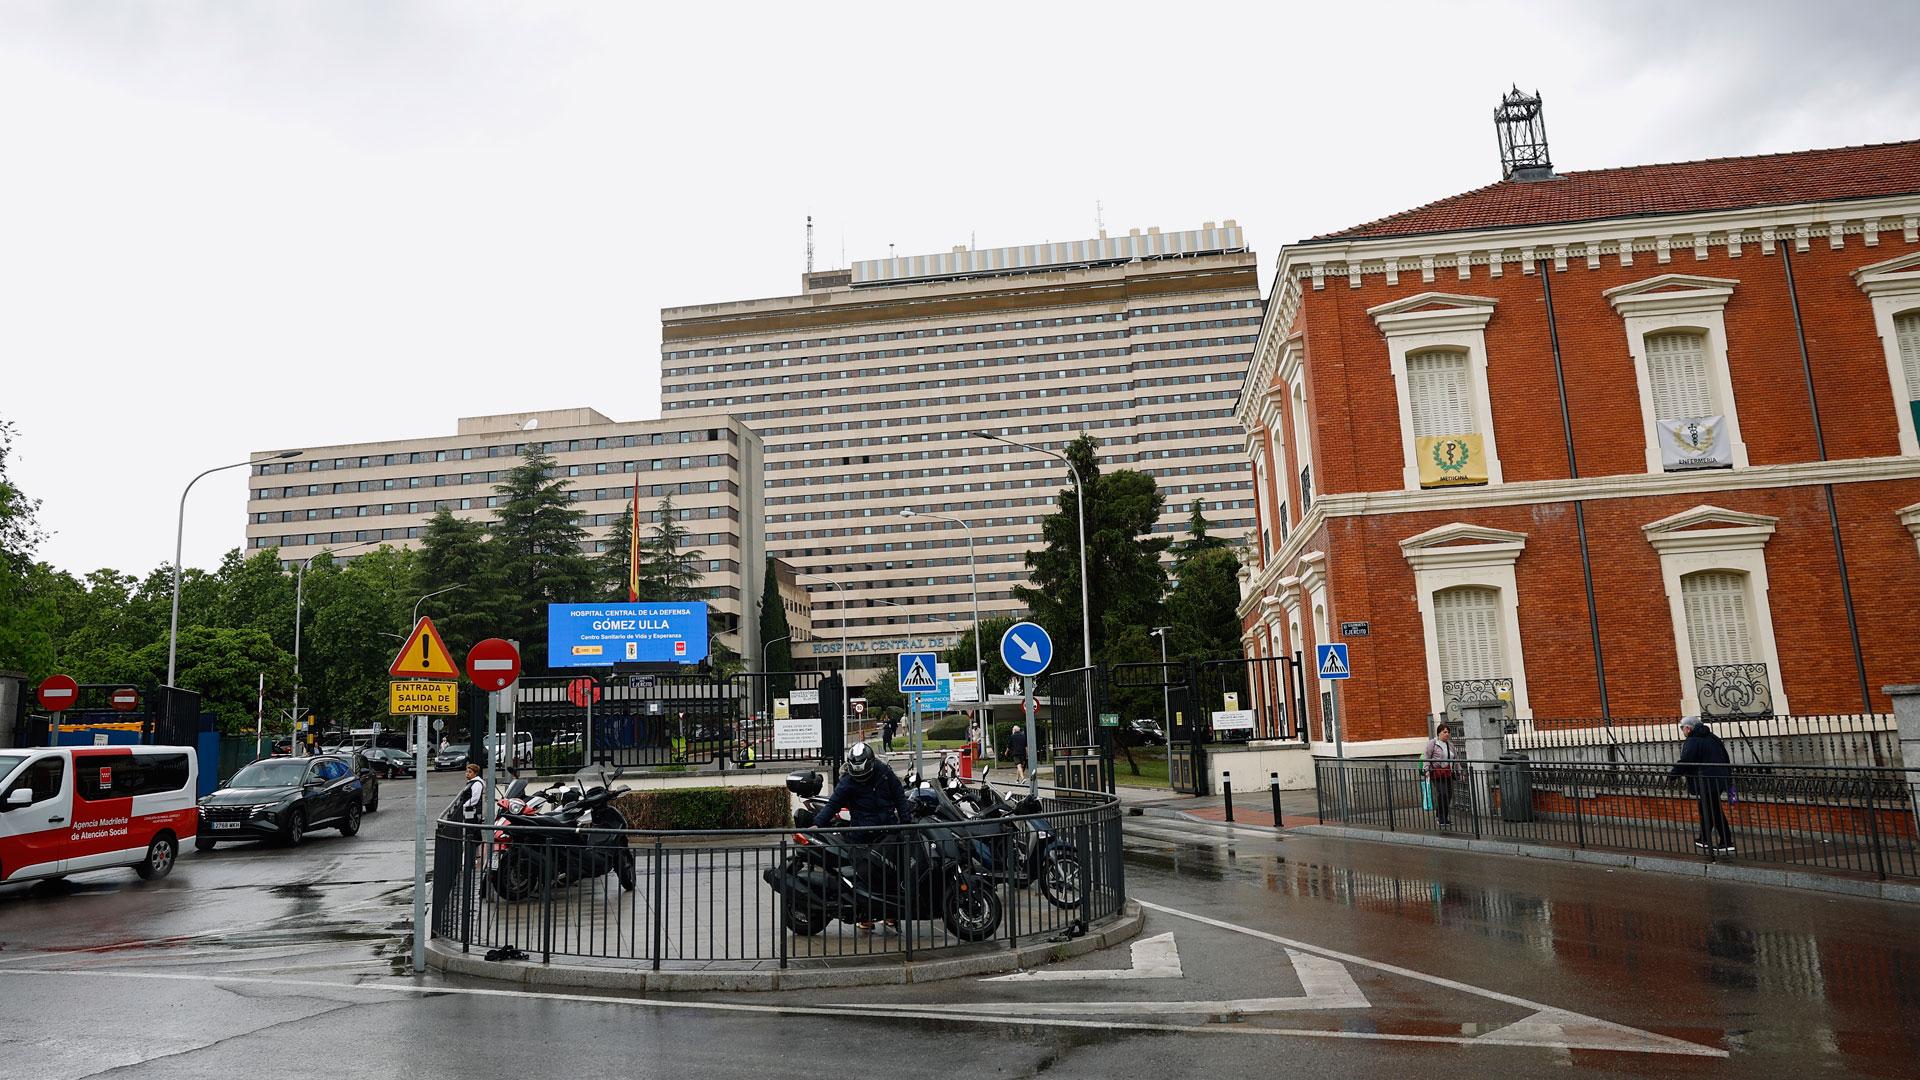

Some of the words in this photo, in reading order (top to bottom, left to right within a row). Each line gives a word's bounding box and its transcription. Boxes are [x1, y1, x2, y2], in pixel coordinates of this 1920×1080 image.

[592, 617, 636, 630] GÓMEZ
[638, 619, 670, 630] ULLA
[812, 640, 869, 654] HOSPTAL
[870, 638, 926, 651] CENTRAL
[928, 637, 944, 648] DE
[398, 694, 433, 702] SALIDA
[72, 820, 98, 830] Agencia
[98, 816, 128, 827] Madrileña
[71, 832, 80, 840] de
[80, 829, 108, 840] Atención
[109, 828, 128, 836] Social
